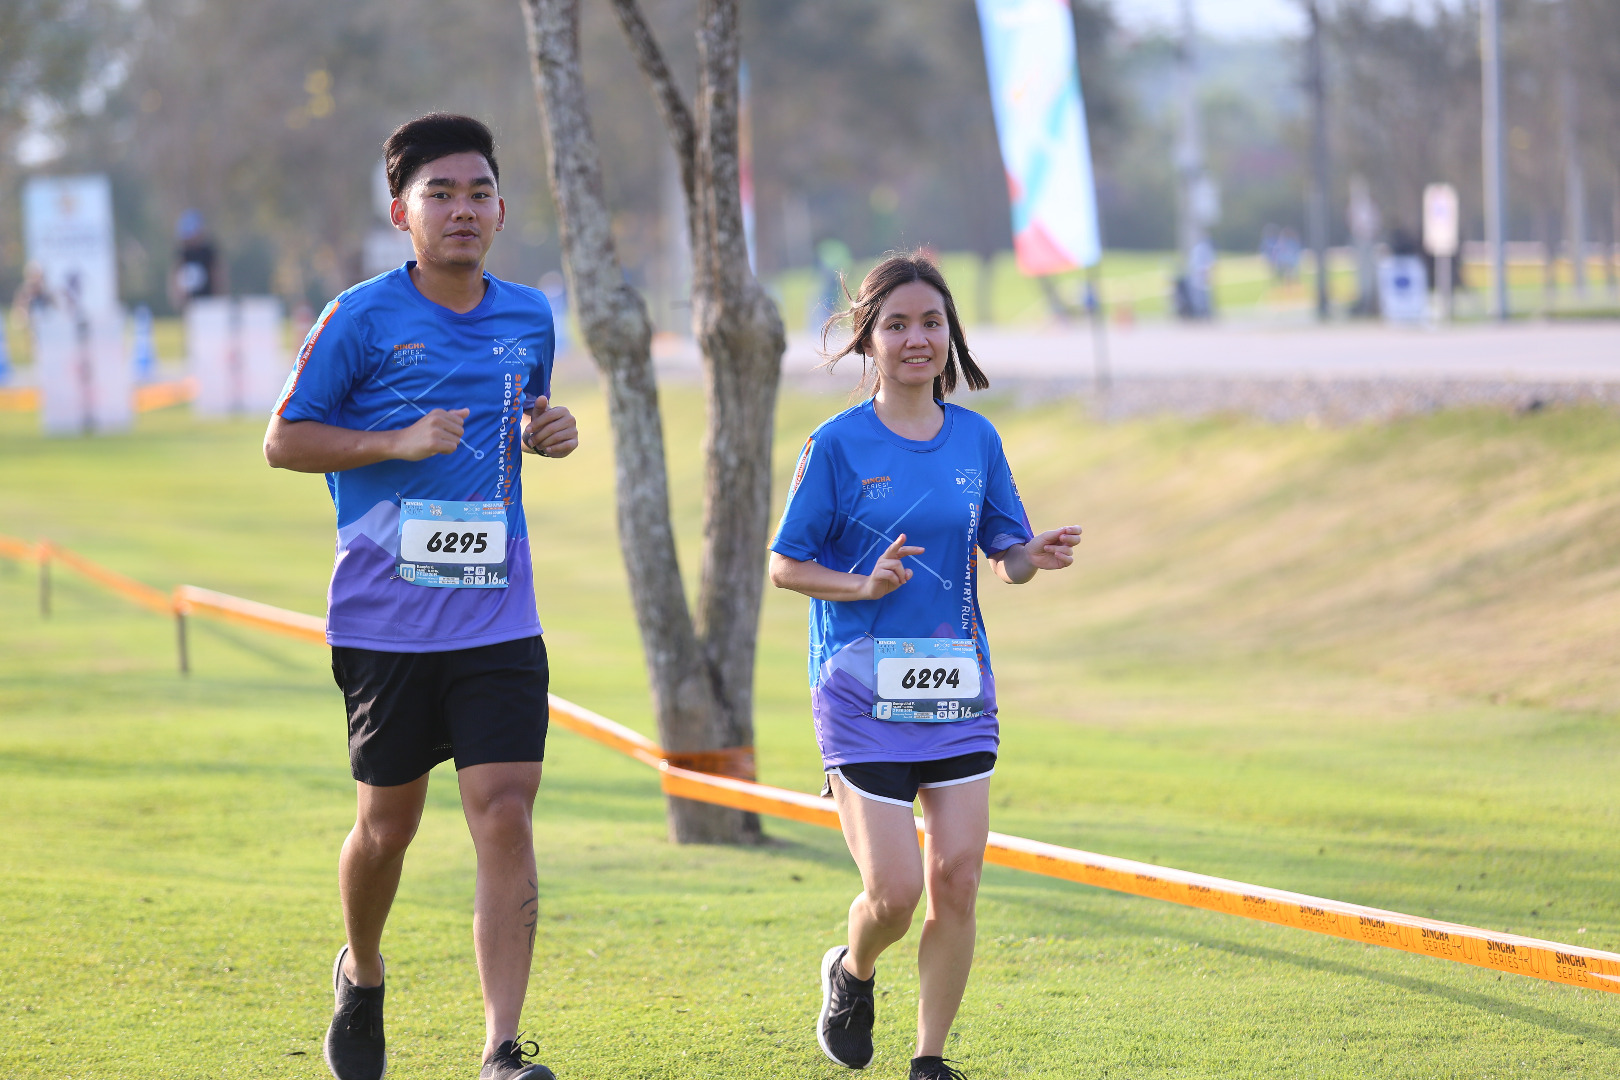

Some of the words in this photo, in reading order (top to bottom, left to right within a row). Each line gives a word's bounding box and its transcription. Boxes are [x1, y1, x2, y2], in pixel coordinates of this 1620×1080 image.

[393, 343, 426, 351] SINGHA
[493, 346, 504, 355] SP
[518, 347, 527, 356] XC
[861, 476, 891, 485] SINGHA
[955, 477, 966, 485] SP
[426, 532, 488, 553] 6295
[961, 605, 971, 630] RUN
[901, 668, 960, 689] 6294
[880, 704, 888, 716] F
[1359, 914, 1386, 929] SINGHA
[1421, 926, 1450, 942] SINGHA
[1423, 938, 1452, 956] SERIES
[1486, 938, 1517, 955] SINGHA
[1488, 952, 1519, 970] SERIES
[1555, 950, 1588, 969] SINGHA
[1556, 965, 1588, 983] SERIES
